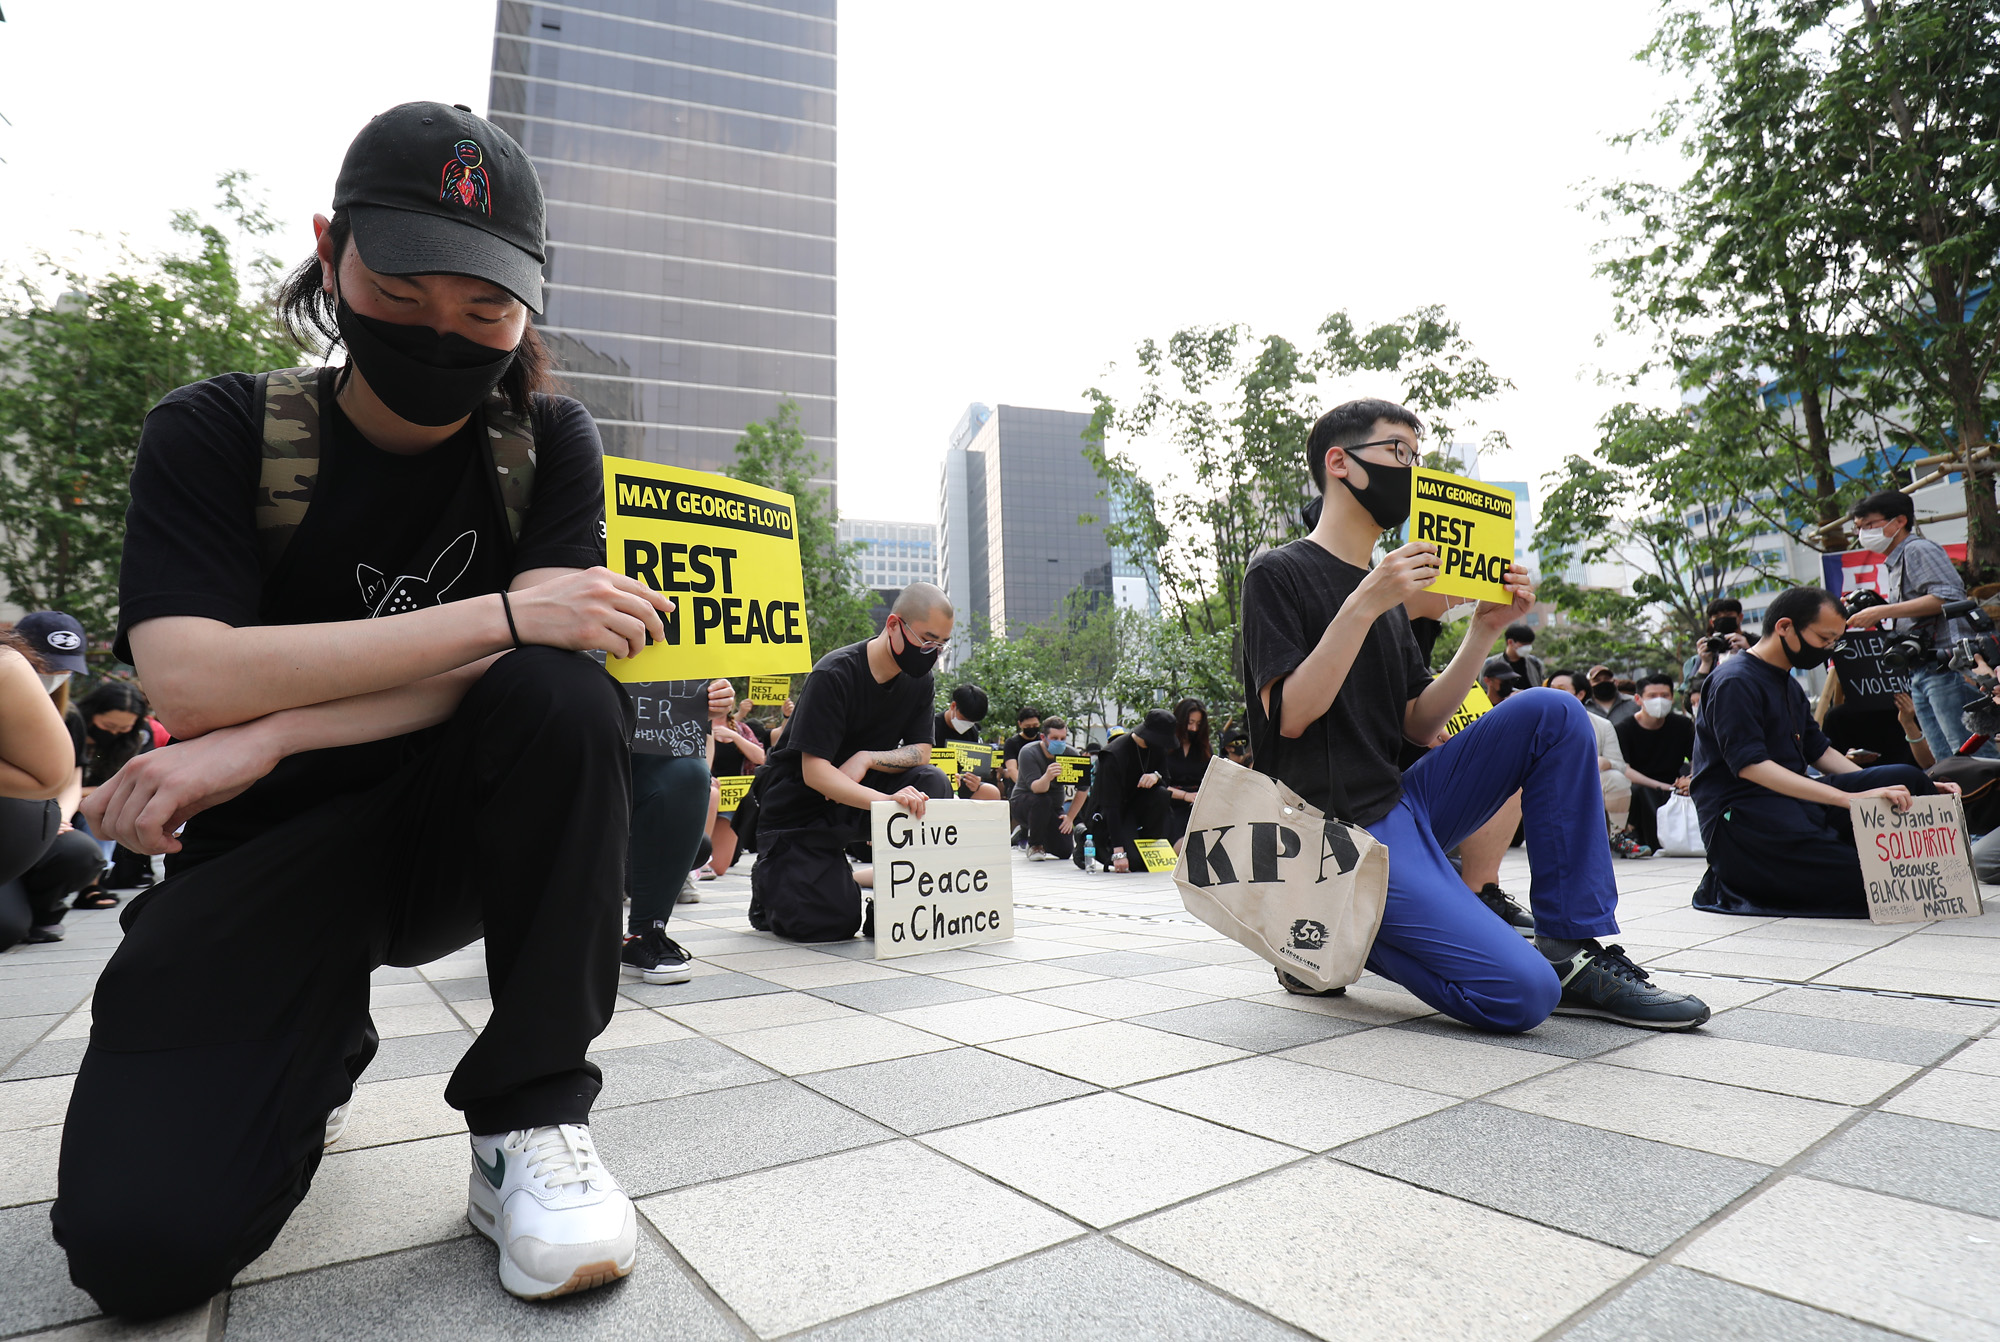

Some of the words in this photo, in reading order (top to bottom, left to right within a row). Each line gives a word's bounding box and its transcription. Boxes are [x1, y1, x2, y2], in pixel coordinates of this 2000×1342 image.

[618, 482, 672, 510] MAY
[676, 491, 747, 522] GEORGE
[749, 504, 791, 531] FLOYD
[1418, 480, 1445, 498] MAY
[1445, 487, 1483, 507] GEORGE
[1485, 496, 1511, 515] FLOYD
[1418, 511, 1475, 548] REST
[624, 539, 737, 594] REST
[1445, 547, 1511, 585] PEACE
[644, 596, 681, 646] N
[693, 596, 803, 645] PEACE
[1843, 636, 1884, 660] SILE
[762, 693, 787, 701] PEACE
[1850, 675, 1912, 696] VIOLEN
[655, 720, 703, 746] KOREA
[1446, 717, 1460, 735] IN
[721, 797, 731, 806] IN
[1859, 805, 1885, 829] We
[1890, 804, 1934, 829] Stand
[1938, 808, 1954, 823] in
[887, 812, 958, 849] Give
[1875, 826, 1957, 862] SOLIDARITY
[1156, 858, 1177, 867] PEAC
[1185, 819, 1360, 888] KPA
[890, 860, 988, 898] Peace
[1890, 861, 1940, 878] because
[1869, 879, 1910, 904] BLACK
[1911, 876, 1948, 902] LIVES
[1923, 896, 1967, 918] MATTER
[891, 922, 906, 943] a
[911, 904, 1000, 941] Chance
